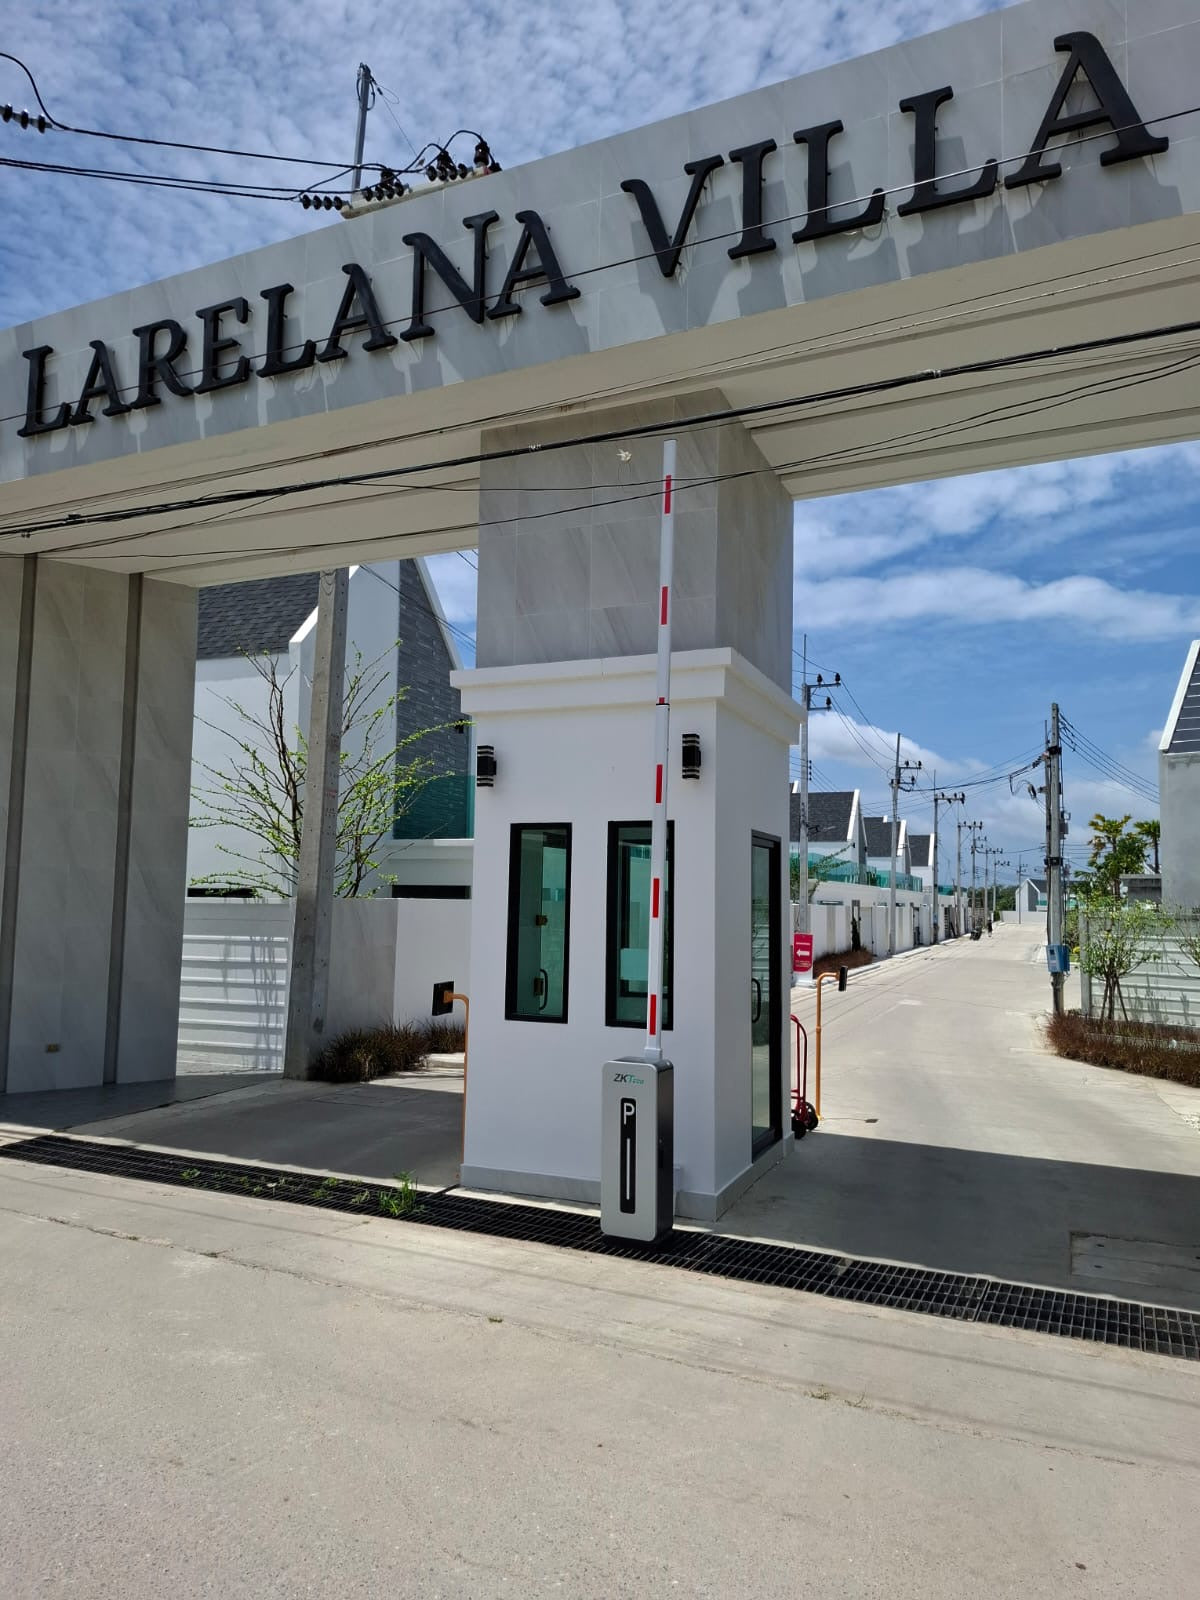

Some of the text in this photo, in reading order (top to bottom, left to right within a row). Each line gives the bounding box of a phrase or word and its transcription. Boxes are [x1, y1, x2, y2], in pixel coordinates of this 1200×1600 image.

[17, 31, 1169, 437] LARELANA VILLA
[623, 1102, 635, 1125] P
